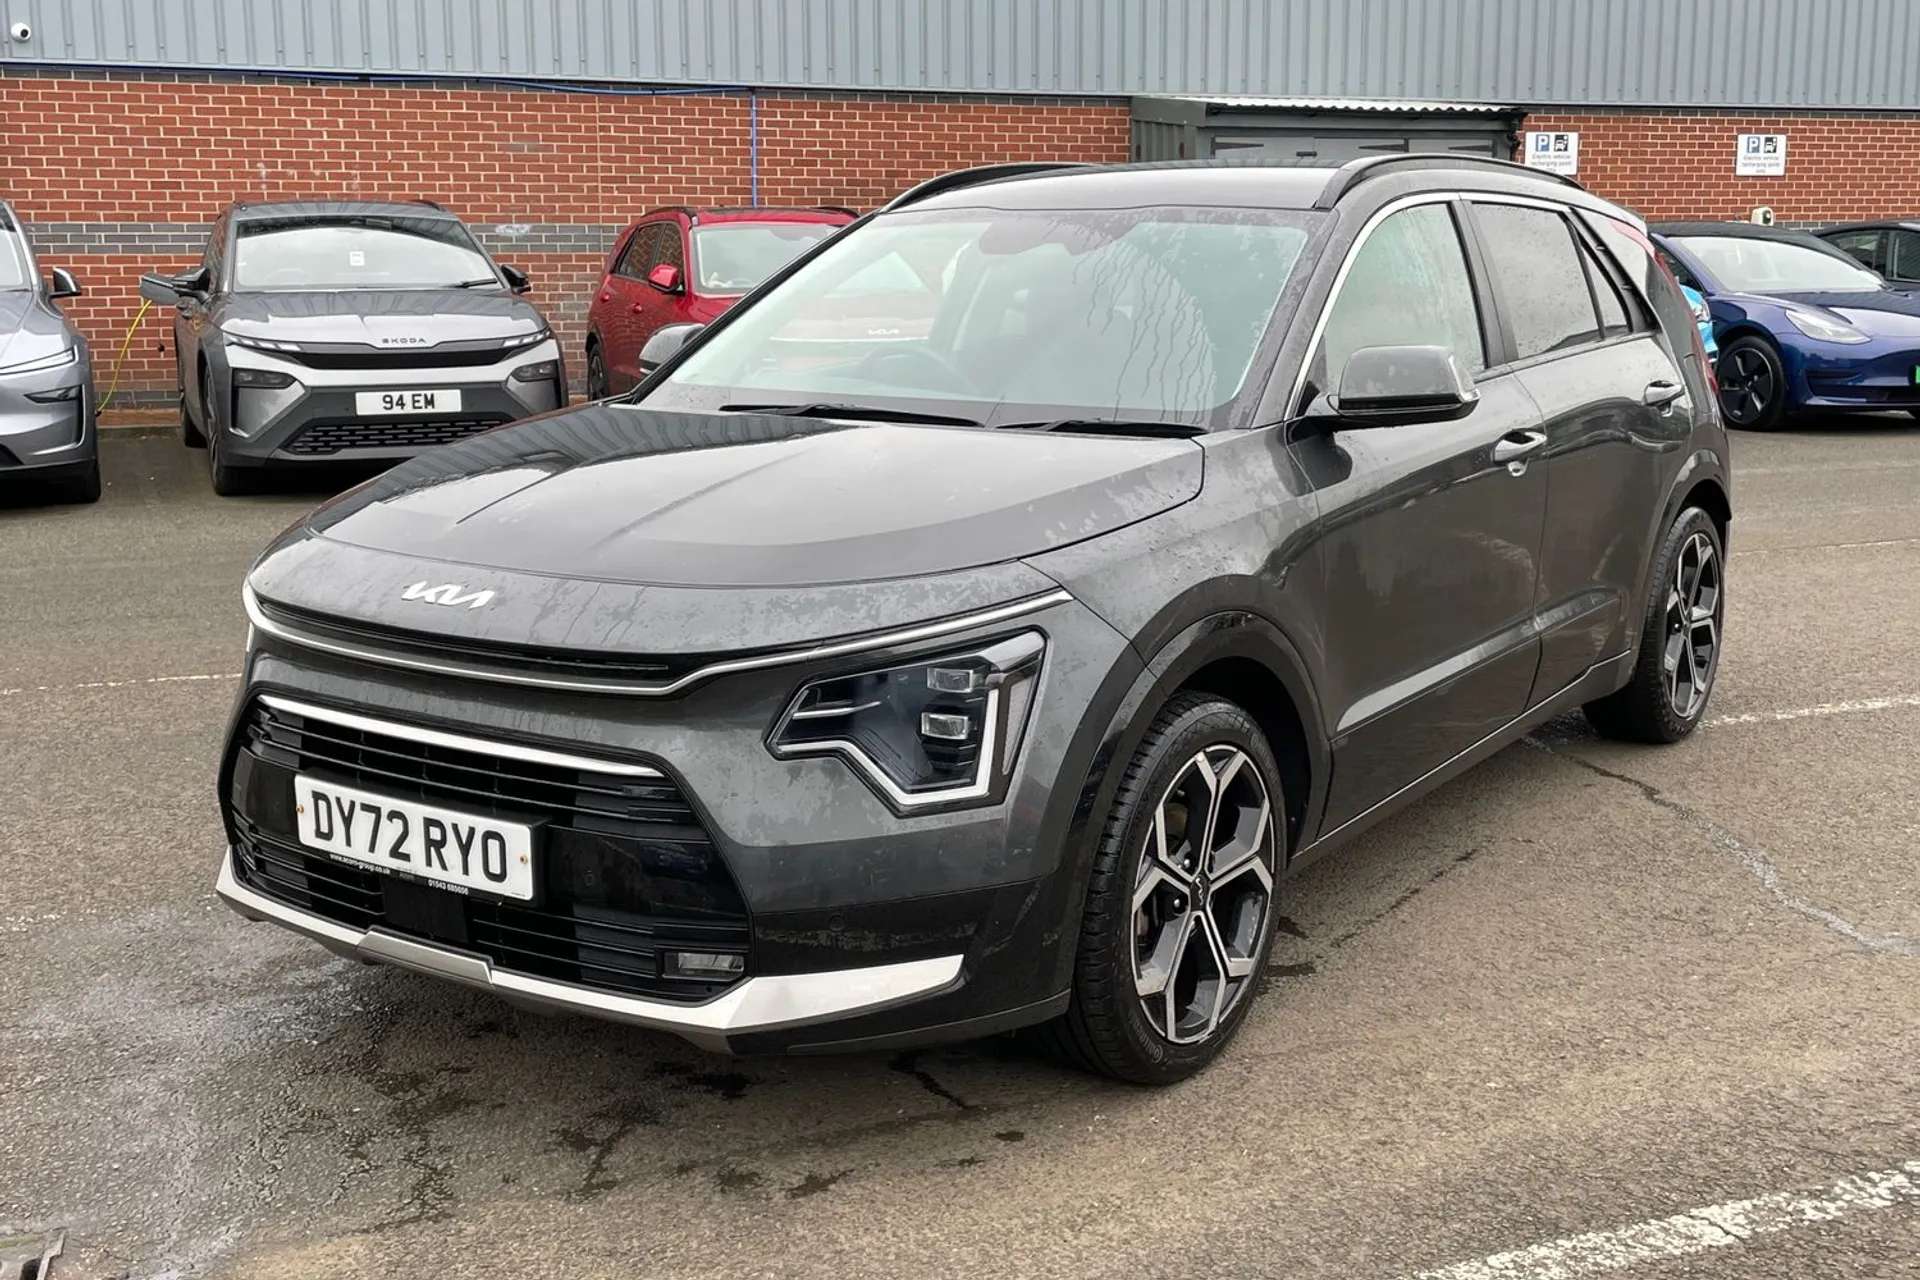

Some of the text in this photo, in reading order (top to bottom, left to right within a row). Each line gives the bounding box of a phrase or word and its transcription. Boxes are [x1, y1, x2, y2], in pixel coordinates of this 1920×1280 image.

[382, 393, 435, 411] 94 EM
[401, 581, 496, 609] KIA
[311, 790, 508, 884] DY72 RYO
